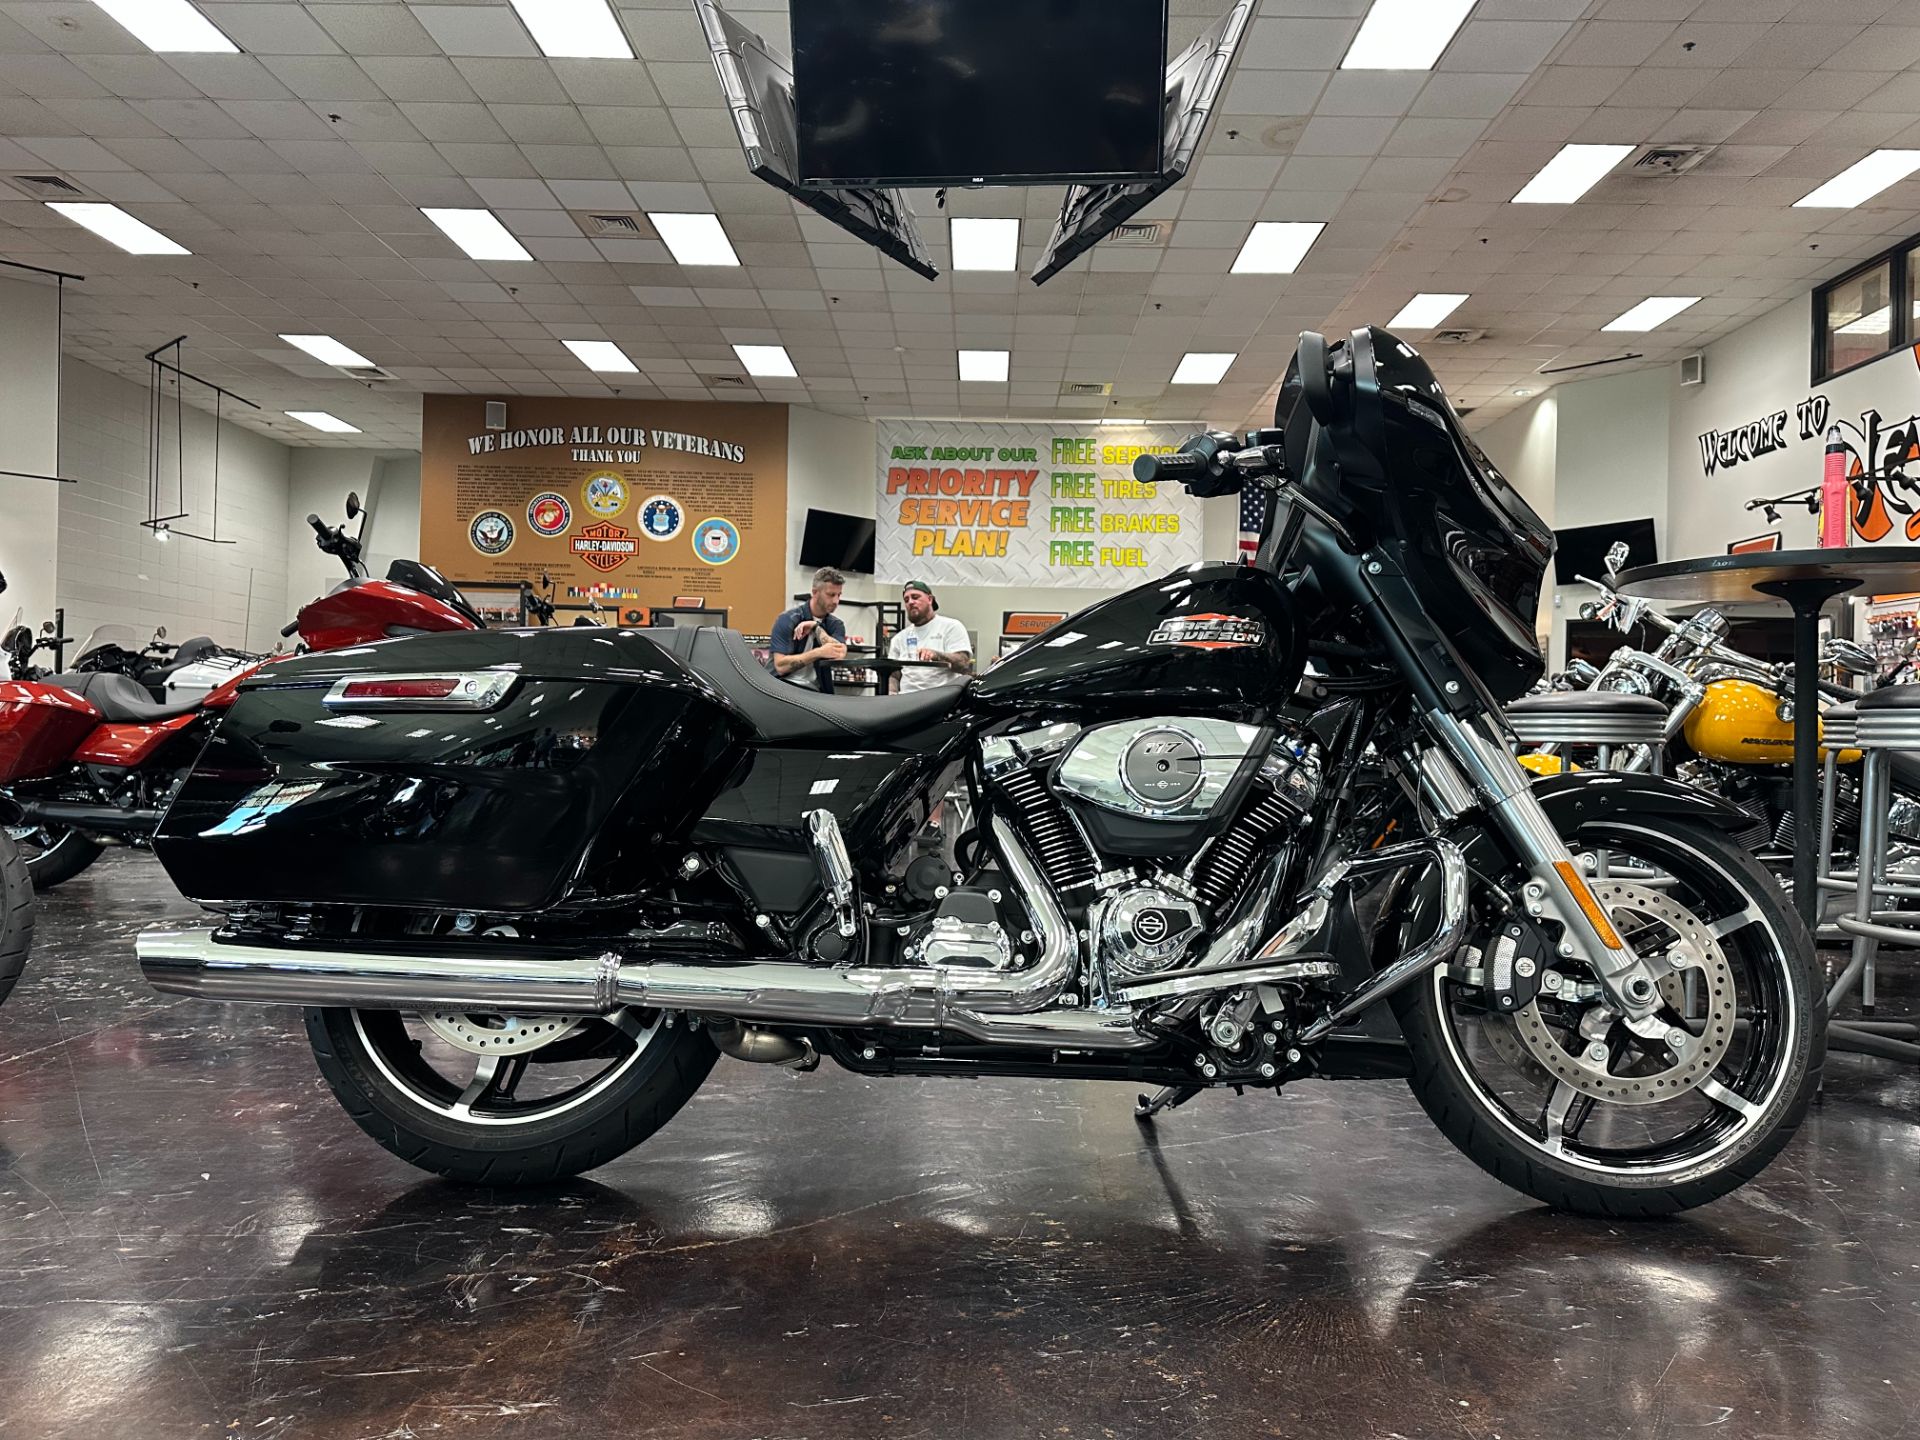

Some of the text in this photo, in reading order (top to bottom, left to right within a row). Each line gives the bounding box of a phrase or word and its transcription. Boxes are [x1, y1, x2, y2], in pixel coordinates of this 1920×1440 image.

[467, 426, 745, 464] WE HONOR ALL OUR VETERANS
[1698, 395, 1831, 477] WELCOME TO
[571, 449, 642, 464] THANK YOU
[890, 445, 1038, 463] ASK ABOUT OUR
[1052, 438, 1096, 465] FREE
[886, 467, 1040, 497] PRIORITY
[1051, 473, 1158, 499] FREE TIRES
[898, 499, 1030, 527] SERVICE
[1050, 506, 1180, 533] FREE BRAKES
[589, 526, 621, 538] MOTOR
[912, 529, 1010, 557] PLAN!
[575, 540, 634, 552] HARLEY-DAVIDSON
[1049, 540, 1148, 567] FREE FUEL
[589, 553, 621, 567] CYCLES
[1152, 631, 1261, 643] DAVIDSON
[1144, 741, 1184, 755] 117
